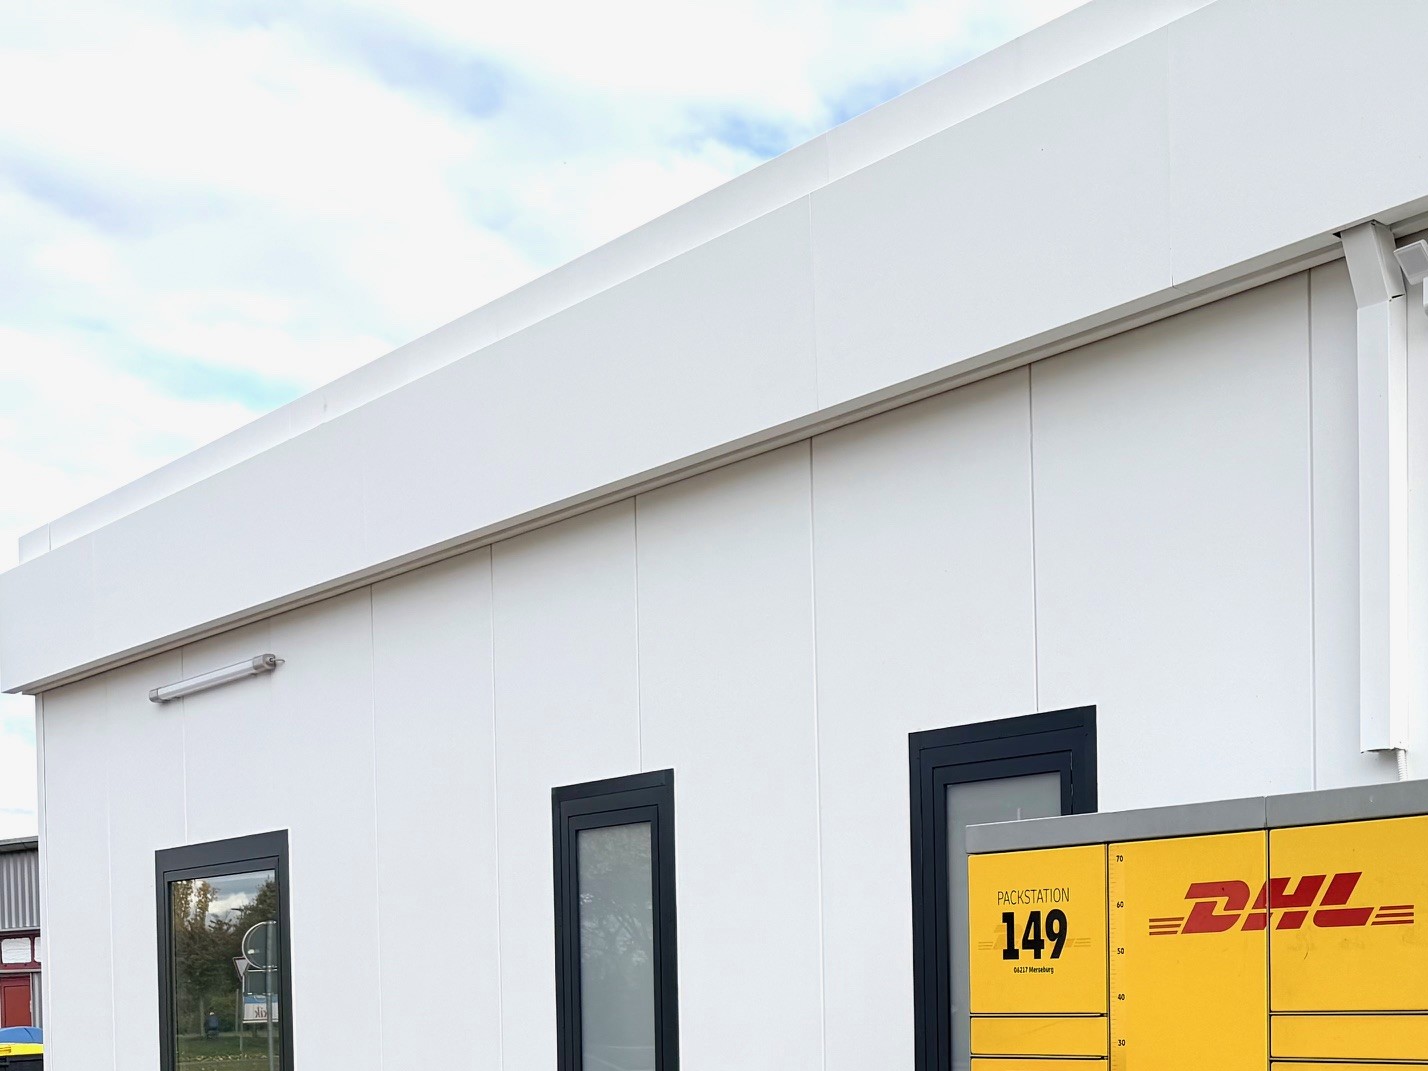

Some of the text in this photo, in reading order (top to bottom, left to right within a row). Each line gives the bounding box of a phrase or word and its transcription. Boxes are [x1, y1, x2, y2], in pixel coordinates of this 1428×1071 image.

[1116, 855, 1124, 863] 70
[997, 887, 1070, 906] PACKSTATION
[1116, 901, 1124, 909] 60
[1181, 871, 1375, 935] DHL
[1001, 908, 1068, 961] 149
[1117, 947, 1125, 955] 50
[1028, 966, 1054, 975] Merseburg
[1117, 993, 1125, 1001] 40
[1117, 1039, 1125, 1047] 30
